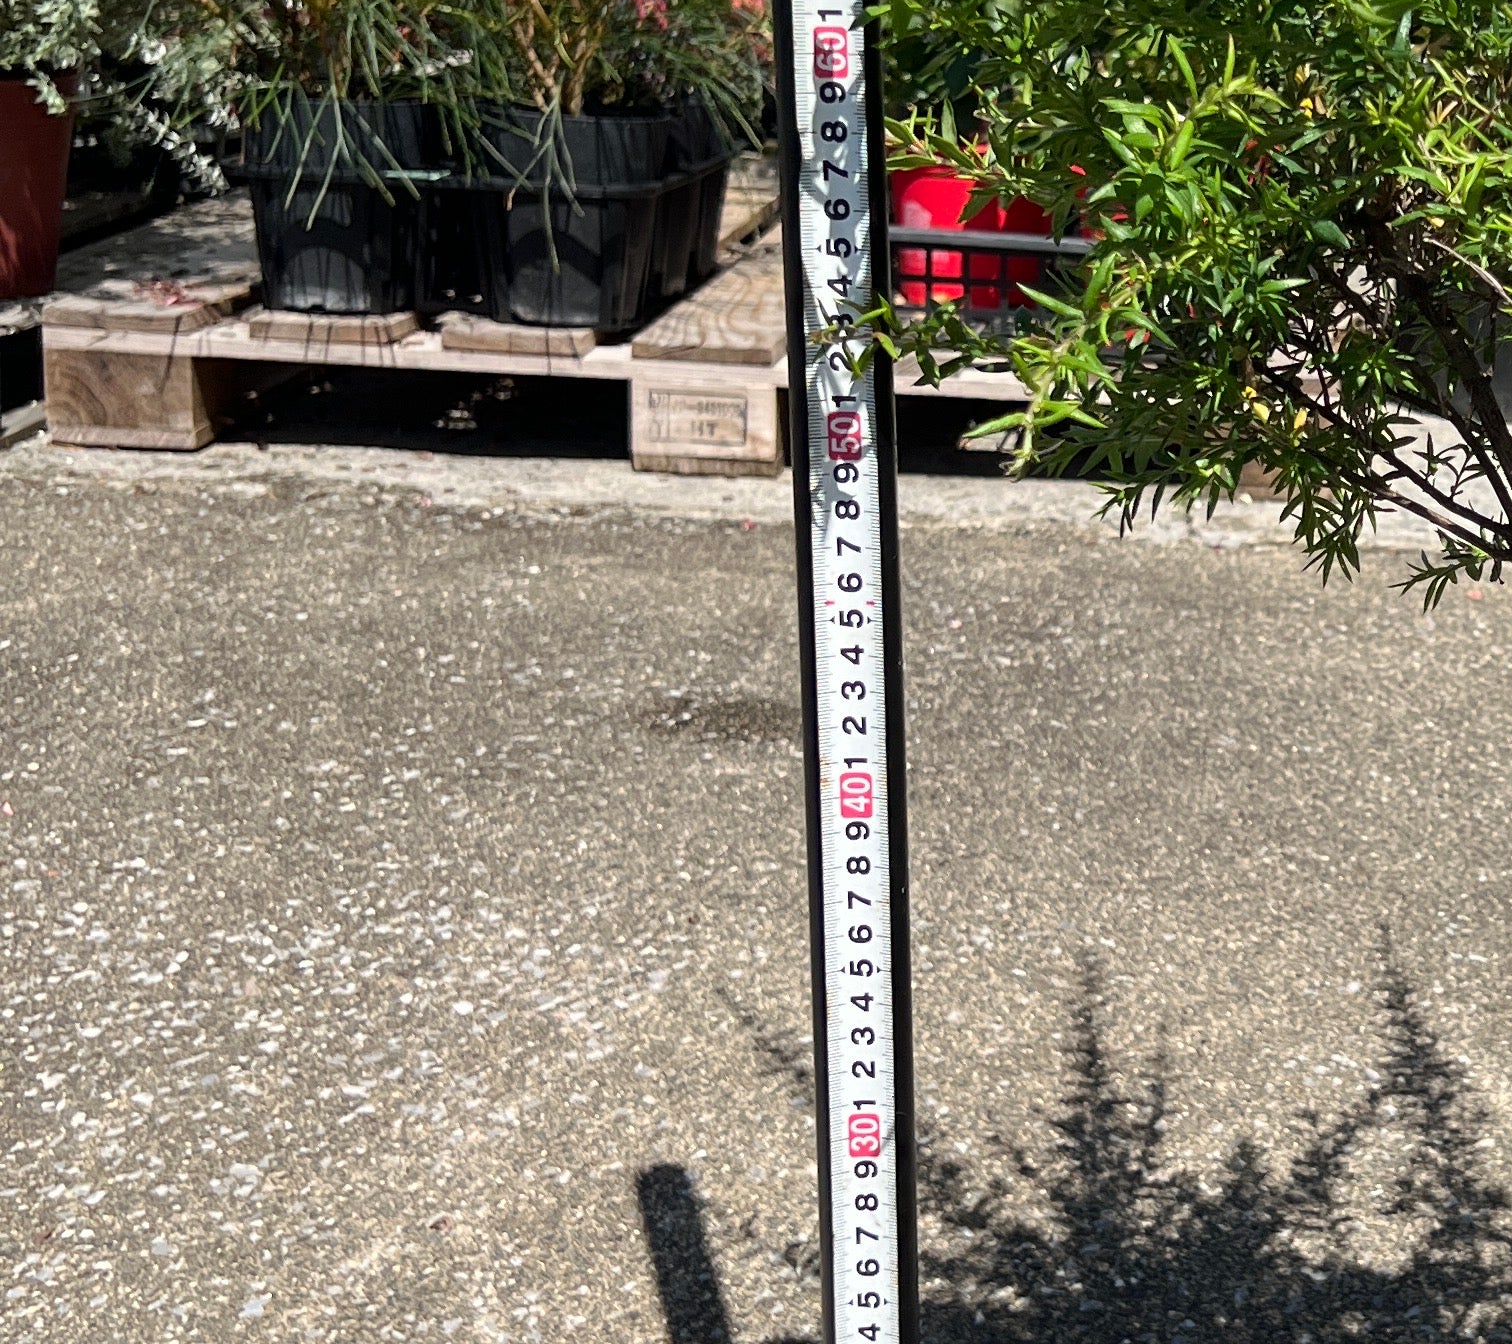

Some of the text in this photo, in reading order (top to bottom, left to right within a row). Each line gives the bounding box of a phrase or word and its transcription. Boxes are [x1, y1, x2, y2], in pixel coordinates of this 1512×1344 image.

[818, 10, 842, 21] 1
[818, 32, 846, 71] 60
[819, 82, 846, 103] 9
[821, 121, 847, 143] 8
[823, 160, 848, 181] 7
[824, 199, 850, 220] 6
[826, 238, 851, 258] 5
[828, 275, 853, 298] 4
[831, 351, 855, 371] 2
[832, 396, 856, 408] 1
[831, 416, 860, 454] 50
[834, 463, 858, 482] 9
[835, 500, 860, 520] 8
[837, 537, 861, 556] 7
[838, 573, 862, 592] 6
[839, 610, 863, 628] 5
[841, 645, 864, 665] 4
[841, 681, 866, 700] 3
[842, 716, 866, 735] 2
[844, 758, 867, 768] 1
[842, 778, 870, 812] 40
[846, 821, 869, 840] 9
[847, 856, 870, 875] 8
[848, 891, 871, 909] 7
[848, 925, 872, 943] 6
[850, 959, 873, 977] 5
[851, 993, 873, 1011] 4
[851, 1027, 875, 1045] 3
[852, 1061, 875, 1078] 2
[853, 1100, 876, 1110] 1
[851, 1118, 878, 1151] 30
[854, 1161, 877, 1178] 9
[855, 1193, 878, 1211] 8
[856, 1227, 878, 1244] 7
[857, 1259, 879, 1276] 6
[857, 1292, 880, 1308] 5
[858, 1324, 880, 1341] 4
